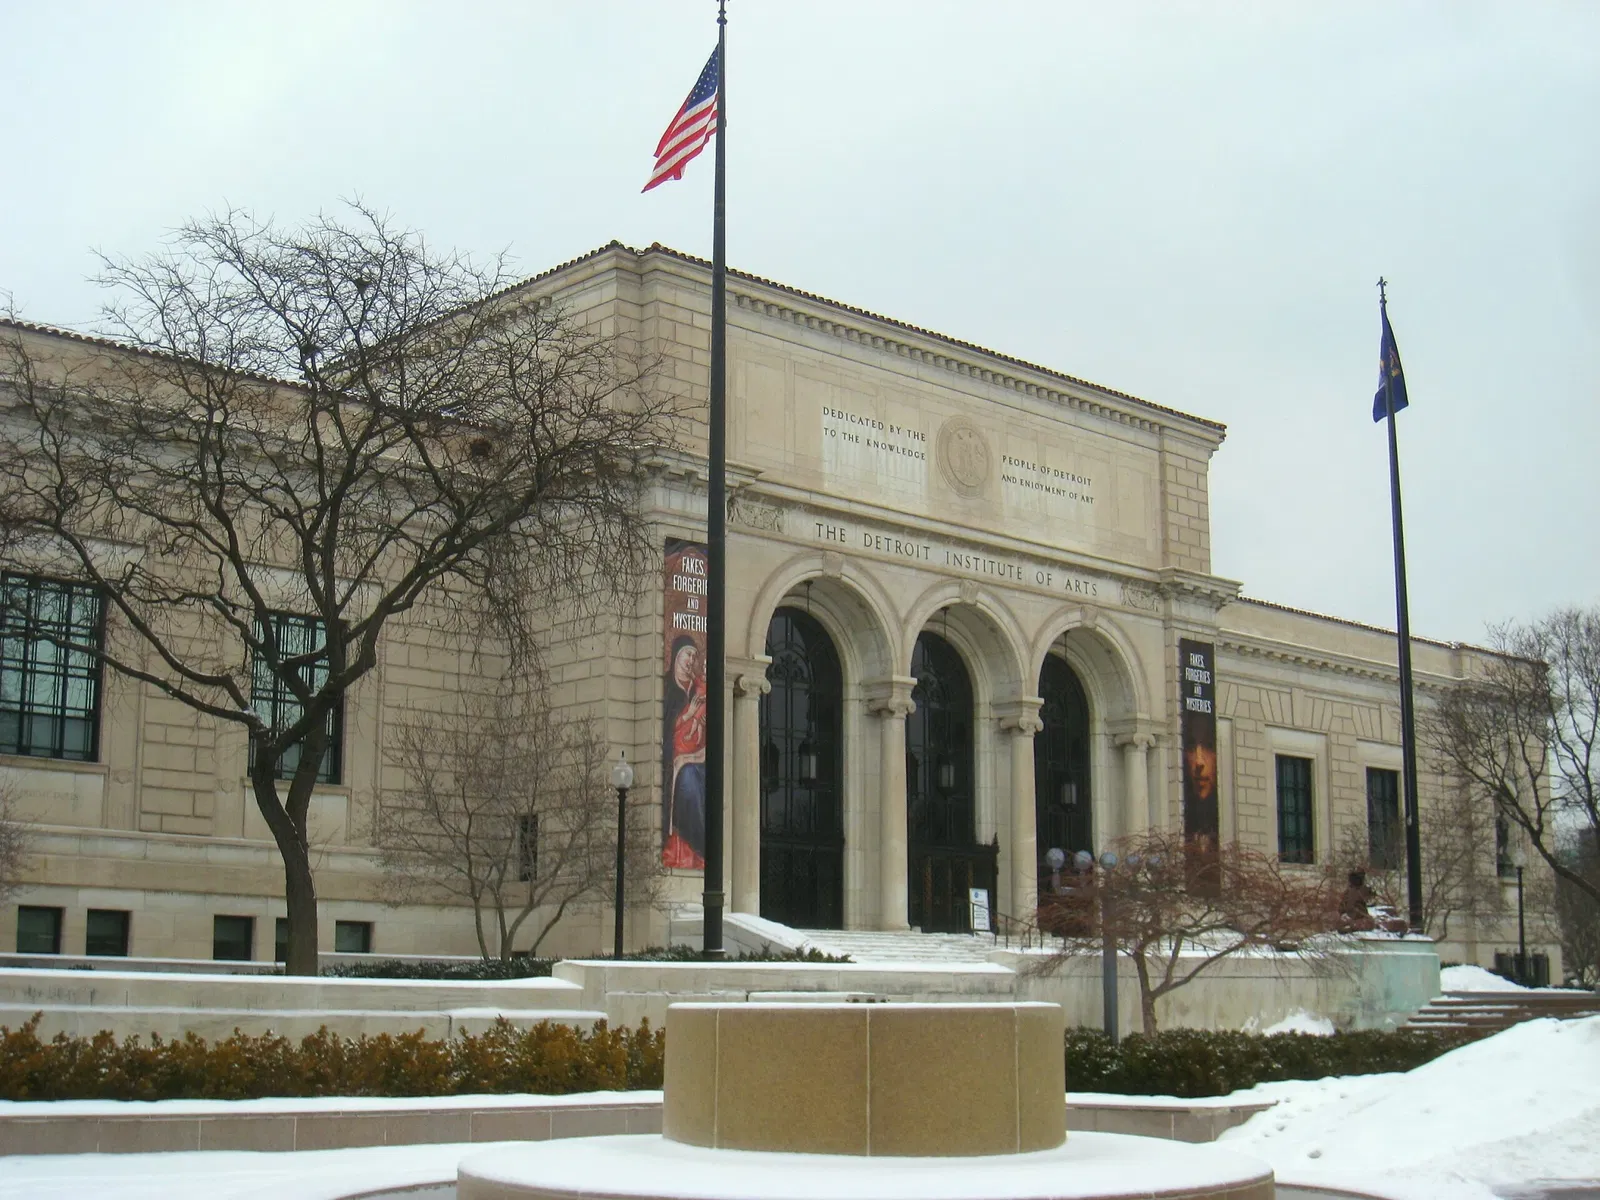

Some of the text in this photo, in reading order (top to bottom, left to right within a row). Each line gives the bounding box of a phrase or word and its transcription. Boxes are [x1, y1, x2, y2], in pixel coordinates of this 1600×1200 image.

[823, 406, 1092, 486] DEDICATED BY THE PEOPLE OF DETROIT
[824, 428, 836, 438] TO
[842, 432, 860, 444] THE
[866, 438, 926, 460] KNOWLEDGE
[1002, 474, 1017, 484] AND
[1068, 492, 1078, 500] OF
[1081, 495, 1094, 504] ART
[682, 556, 706, 576] FAKES,
[815, 523, 1098, 596] THE DETROIT INSTITUTE OF ARTS
[673, 574, 708, 596] FORGERIE
[687, 598, 699, 610] AND
[673, 612, 707, 633] MYSTERIE
[1186, 667, 1210, 684] FORGERIES
[1186, 697, 1212, 714] MYSTERIES
